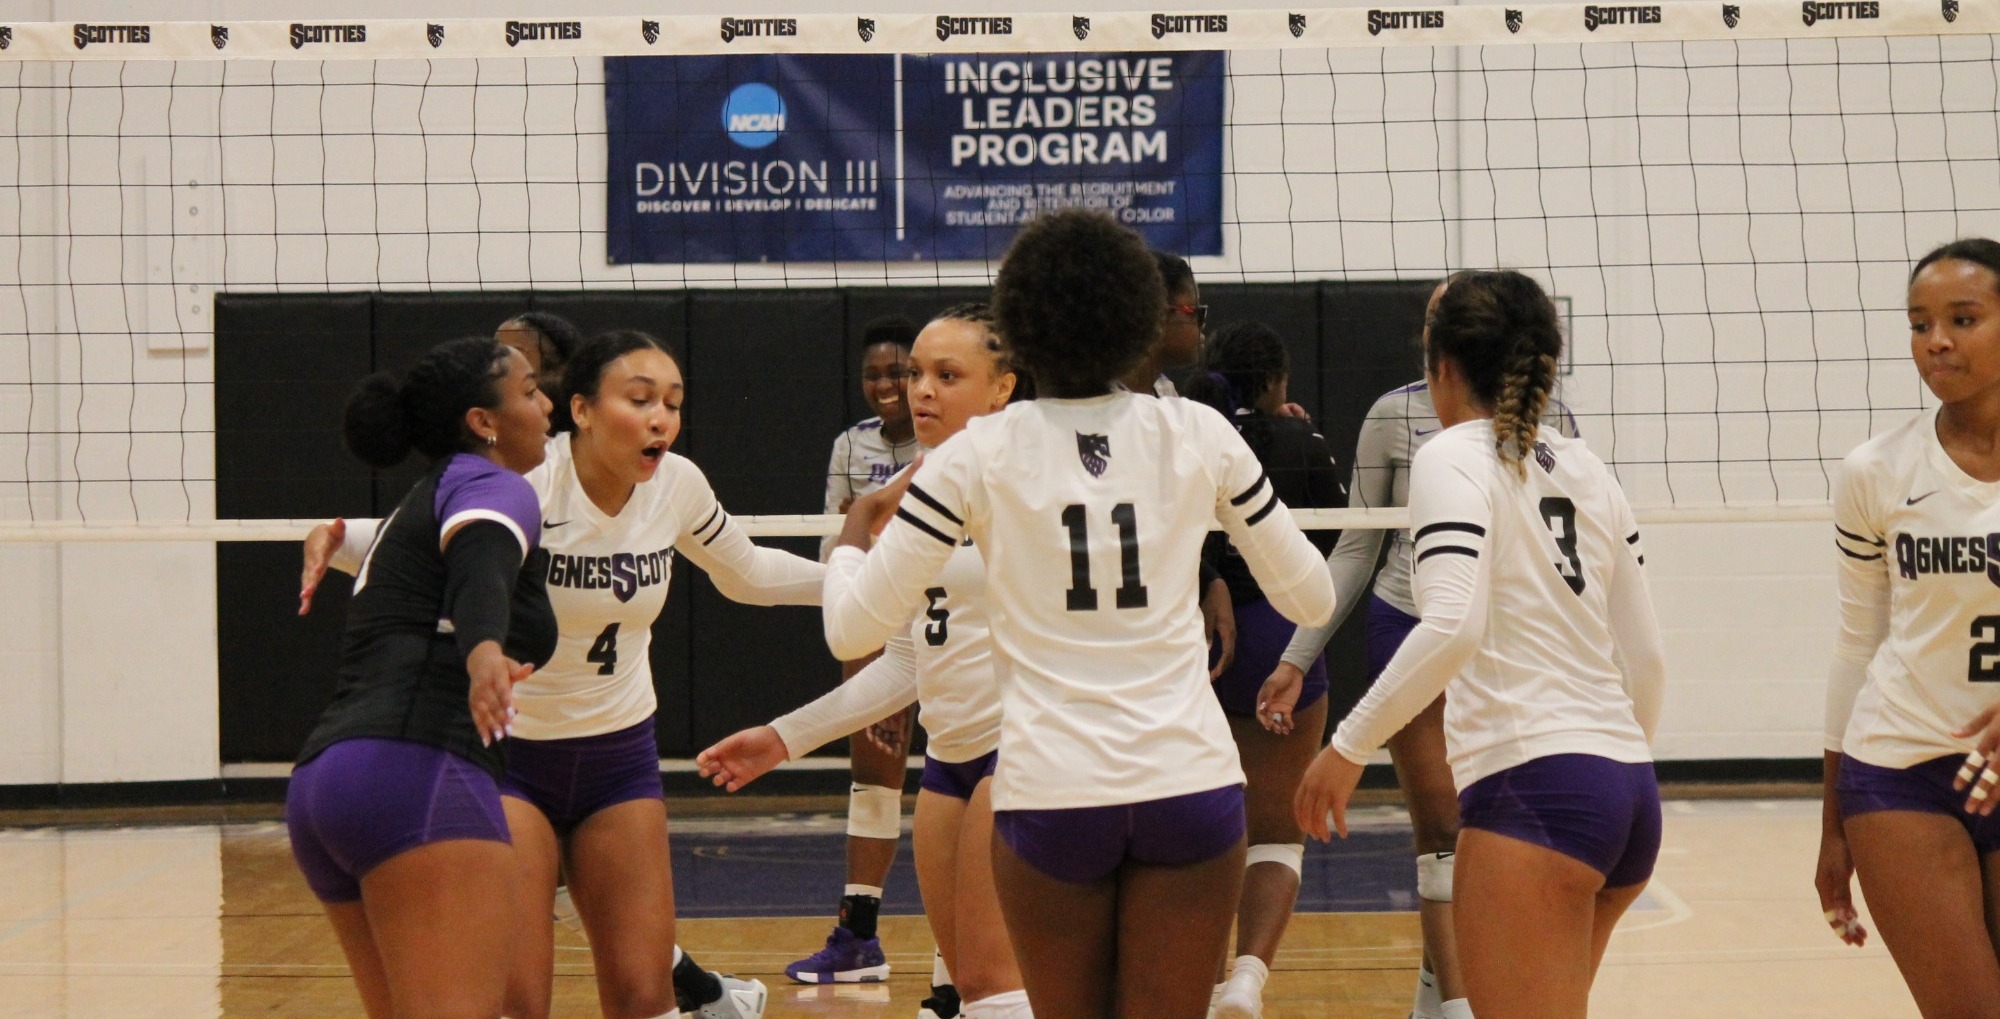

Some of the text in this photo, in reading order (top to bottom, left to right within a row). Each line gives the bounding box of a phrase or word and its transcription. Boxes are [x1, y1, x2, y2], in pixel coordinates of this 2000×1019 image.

[1151, 13, 1228, 40] SCOTTIES
[1367, 9, 1444, 36] SCOTTIES
[1584, 5, 1661, 32] SCOTTIES
[1802, 0, 1879, 26] SCOTTIES
[73, 23, 150, 50] SCOTTIES
[289, 23, 366, 50] SCOTTIES
[505, 20, 582, 47] SCOTTIES
[720, 17, 797, 44] SCOTTIES
[936, 15, 1013, 42] SCOTTIES
[944, 58, 1174, 94] INCLUSIVE
[727, 114, 786, 132] NCAA
[962, 94, 1157, 129] LEADERS
[951, 130, 1168, 167] PROGRAM
[635, 160, 878, 197] DIVISION III
[943, 181, 1176, 199] ADVANCING THE RECRUITMENT
[636, 198, 877, 213] DISCOVER DEVELOP DEDICATE
[987, 198, 1021, 211] AND
[1124, 206, 1175, 222] COLOR
[1061, 503, 1148, 611] 11
[1539, 496, 1586, 596] 3
[924, 587, 950, 646] 5
[586, 622, 621, 676] 4
